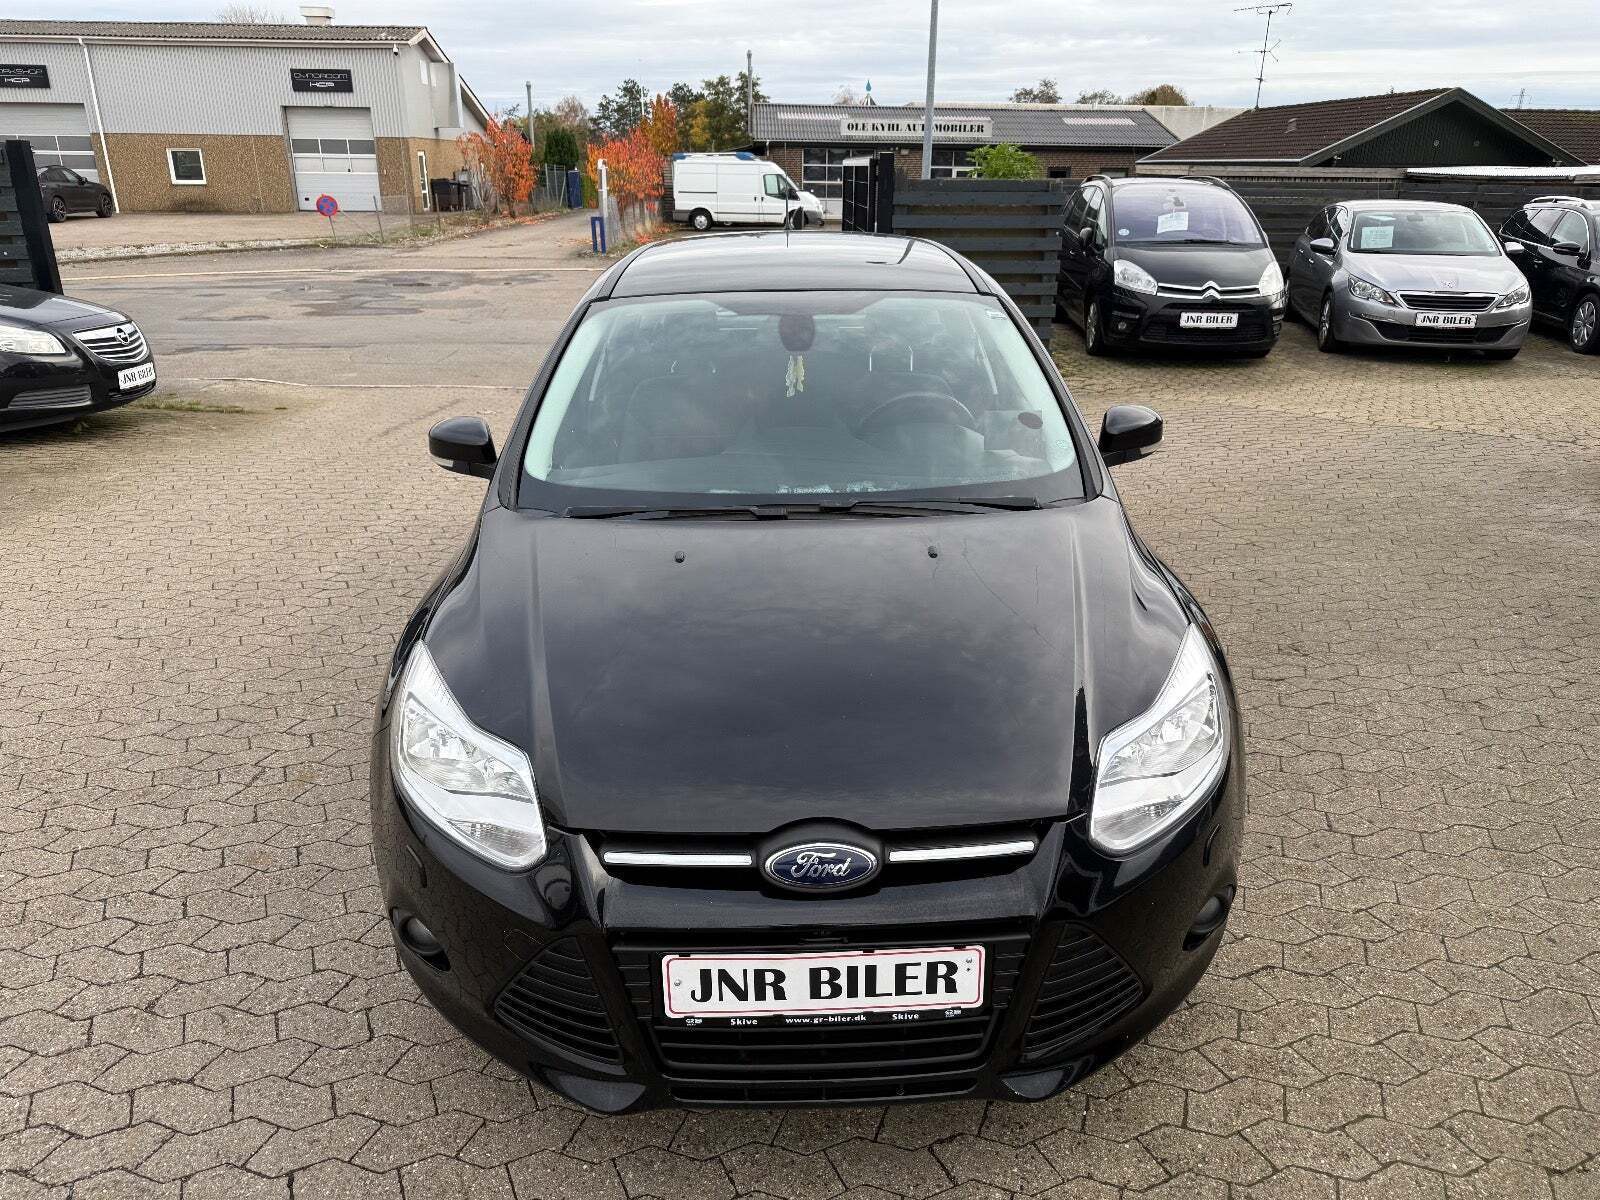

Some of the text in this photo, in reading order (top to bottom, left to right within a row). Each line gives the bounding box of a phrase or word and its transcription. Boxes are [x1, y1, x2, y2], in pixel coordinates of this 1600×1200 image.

[847, 122, 985, 133] OLE KYHL AUTMOBILER
[1184, 315, 1233, 324] JNR BILER
[1420, 315, 1472, 325] JNR BILER
[123, 371, 137, 385] JNR
[790, 851, 852, 878] Ford
[690, 960, 960, 1003] JNR BILER
[730, 1012, 920, 1026] Skive www.gr-biler.dk Skive
